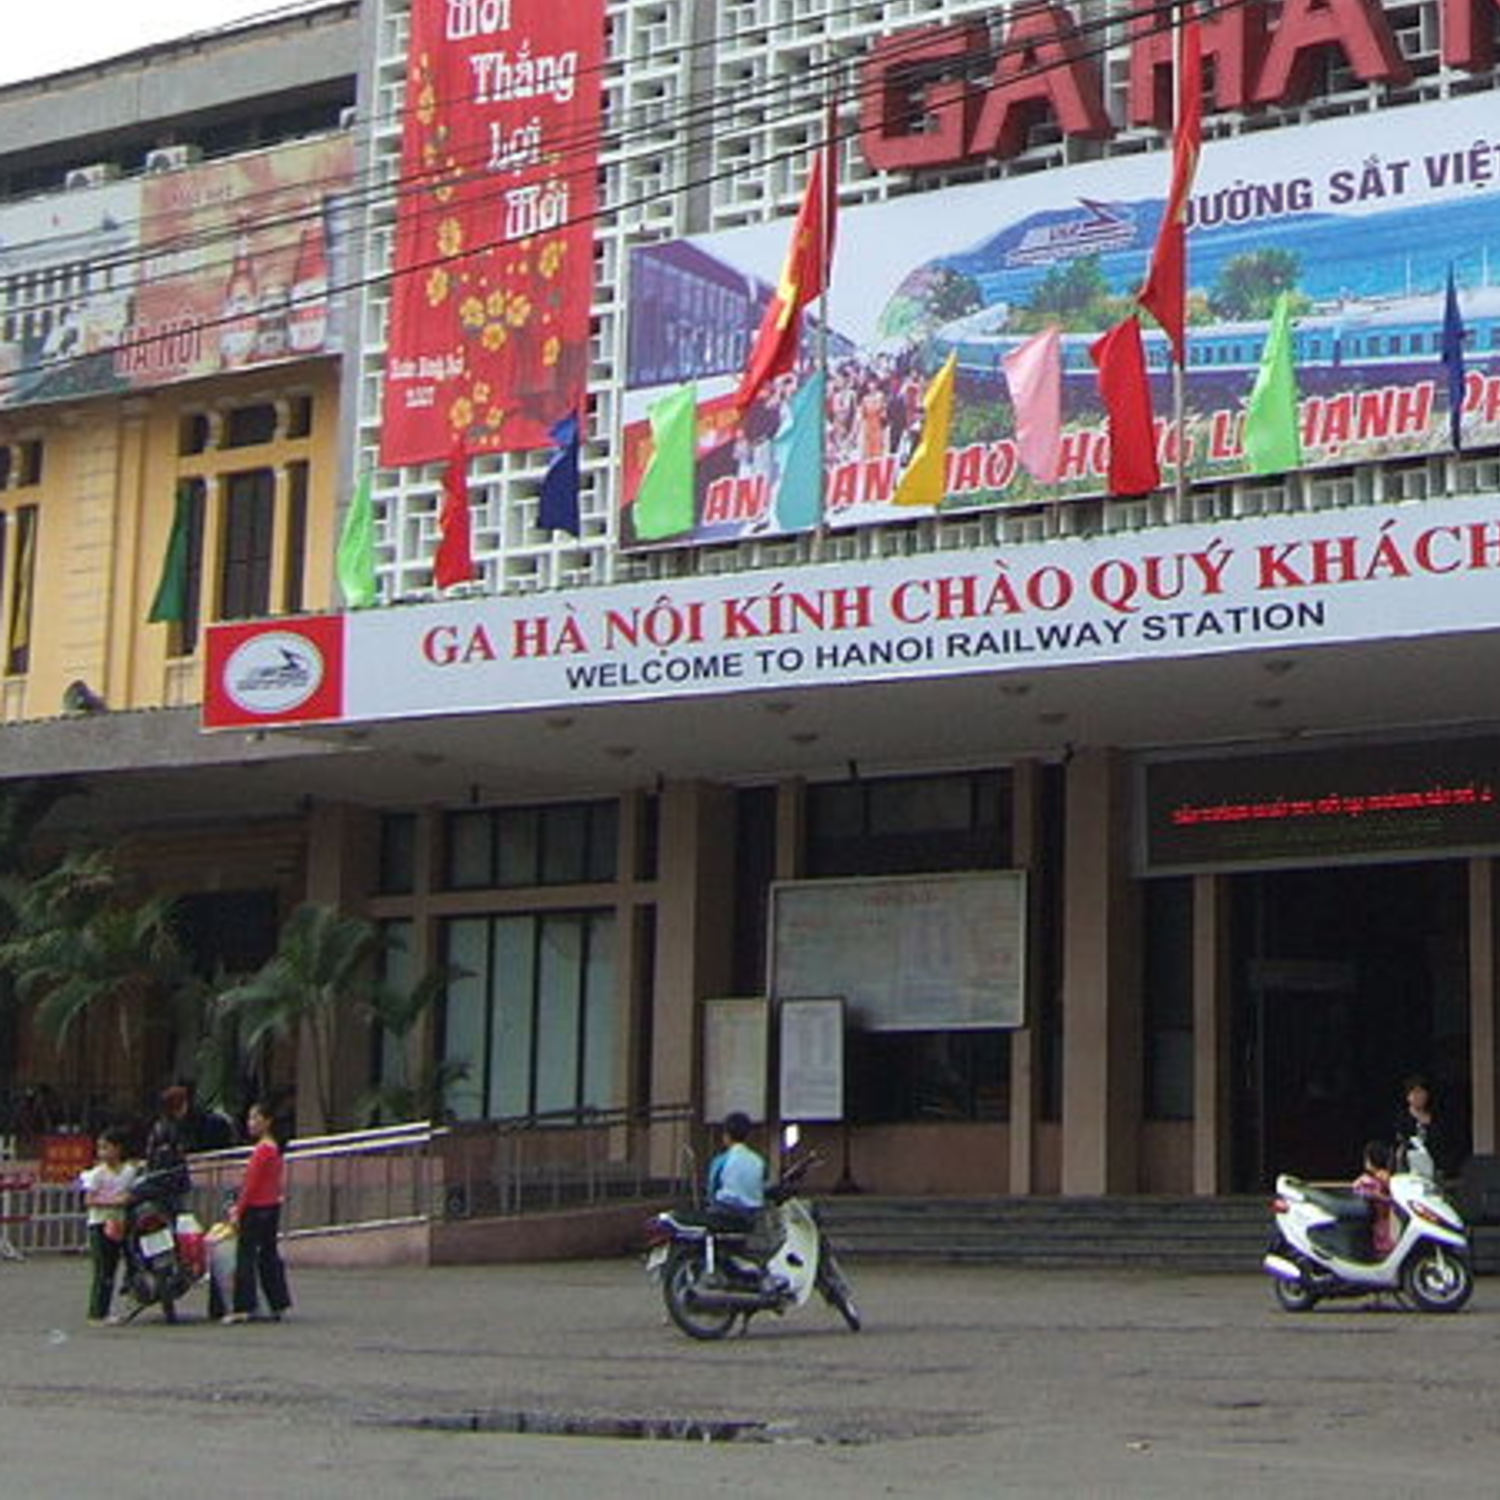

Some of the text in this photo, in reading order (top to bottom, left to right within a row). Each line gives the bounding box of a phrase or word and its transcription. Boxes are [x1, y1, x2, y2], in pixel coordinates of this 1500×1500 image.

[470, 38, 579, 104] Thắng
[858, 2, 1112, 172] GA
[1328, 153, 1410, 205] SẮT
[705, 476, 767, 522] AN
[422, 624, 497, 667] GA
[511, 603, 590, 659] HÀ
[604, 595, 707, 657] NỘI
[722, 581, 873, 641] KÍNH
[890, 559, 1075, 625] CHÀO
[1089, 538, 1233, 613] QUÝ
[566, 601, 1326, 690] WELCOME TO HANOI RAILWAY STATION
